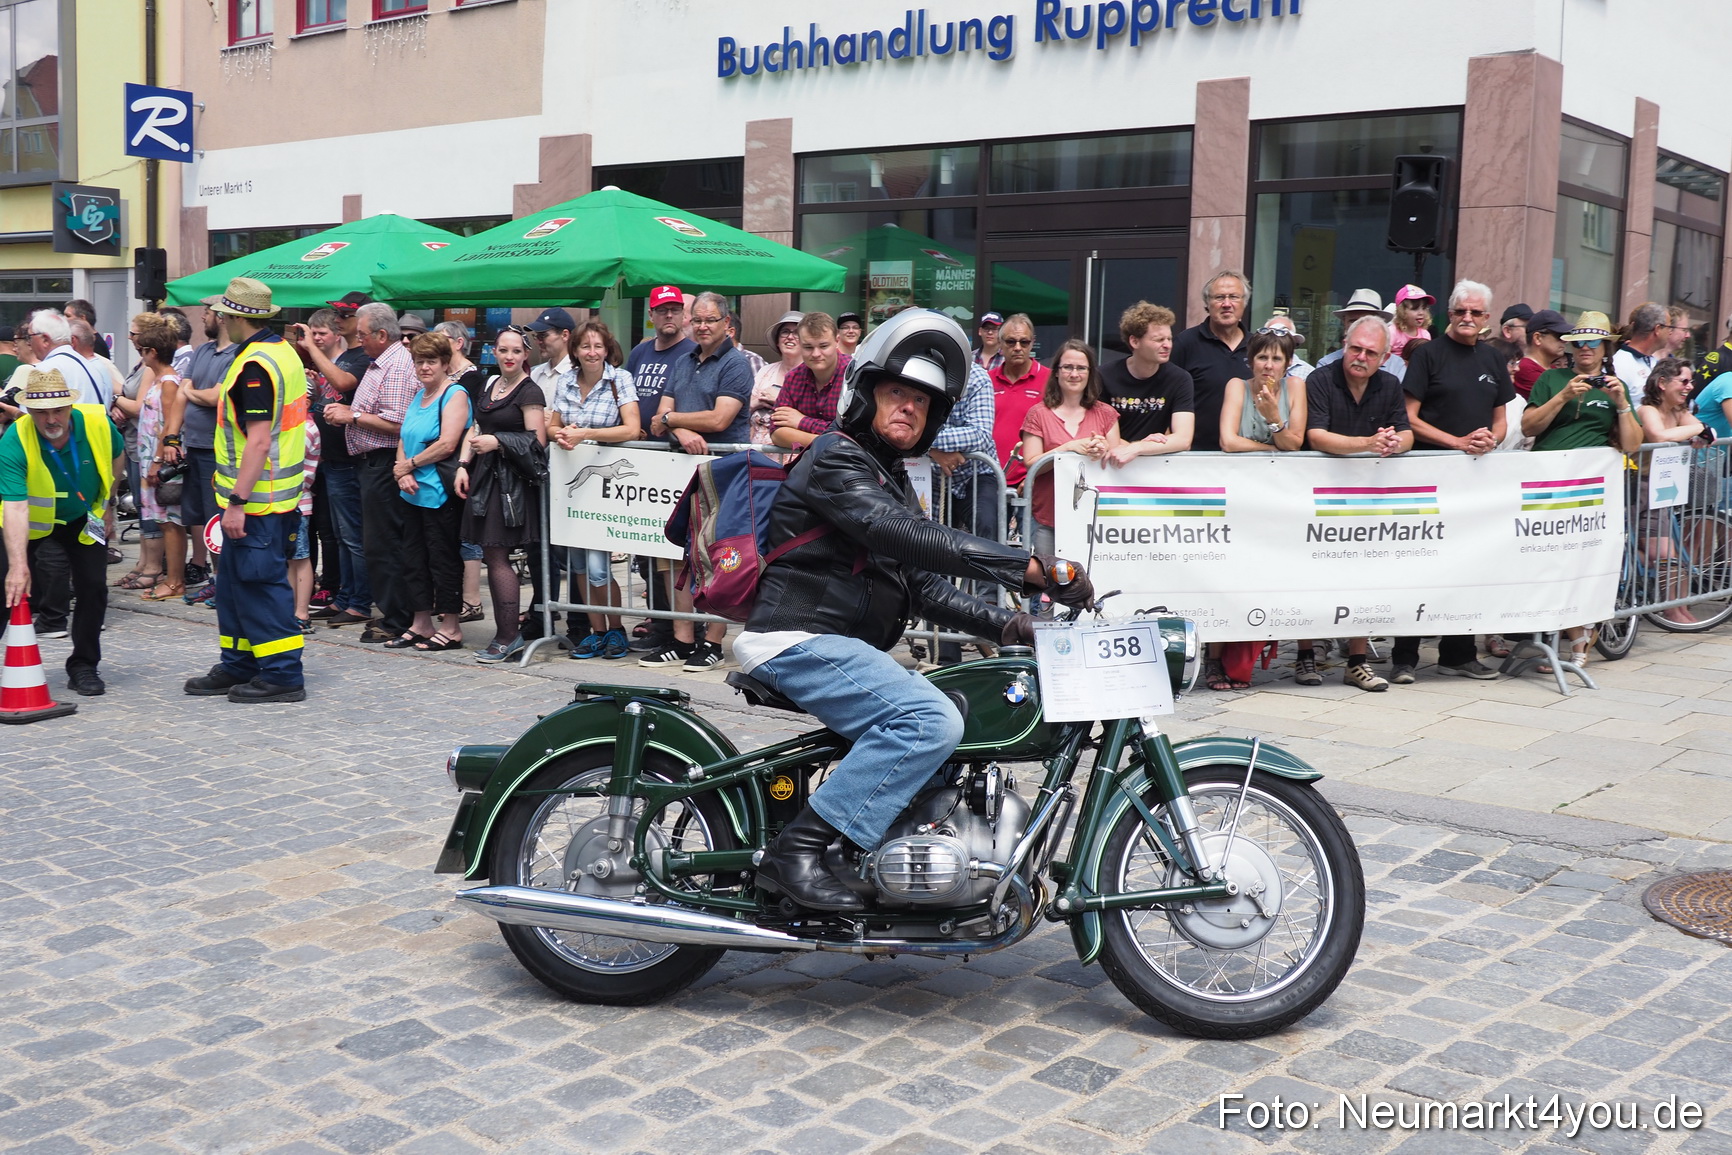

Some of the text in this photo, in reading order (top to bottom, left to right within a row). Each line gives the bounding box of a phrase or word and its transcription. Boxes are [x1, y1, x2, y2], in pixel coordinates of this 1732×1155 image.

[718, 8, 1017, 78] Buchhandlung
[199, 180, 253, 197] Unterer Markt 15
[81, 204, 106, 233] G2
[486, 239, 561, 252] Neumarkter
[453, 248, 561, 263] Lammsbräu
[265, 263, 330, 271] Neumarkter
[935, 266, 975, 280] MÄNNER
[240, 270, 328, 280] Lammsbräu
[871, 276, 909, 289] OLDTIMER
[638, 363, 668, 375] DEER
[602, 477, 683, 507] Express
[1514, 511, 1607, 538] NeuerMarkt
[606, 526, 666, 544] Neumarkt
[1086, 522, 1231, 544] NeuerMarkt
[1306, 520, 1445, 543] NeuerMarkt
[1311, 548, 1439, 560] einkaufen leben genießen
[1520, 543, 1560, 554] einkaufen
[1562, 541, 1579, 551] leben
[1093, 551, 1226, 563] einkaufen leben genießen
[1209, 608, 1215, 617] 1
[1270, 607, 1304, 616] Mo.-Sa.
[1375, 604, 1392, 613] 500
[1203, 618, 1211, 628] d.
[1268, 618, 1314, 627] 10-20 Uhr
[1427, 611, 1483, 622] NM-Neumarkt
[1097, 635, 1142, 660] 358
